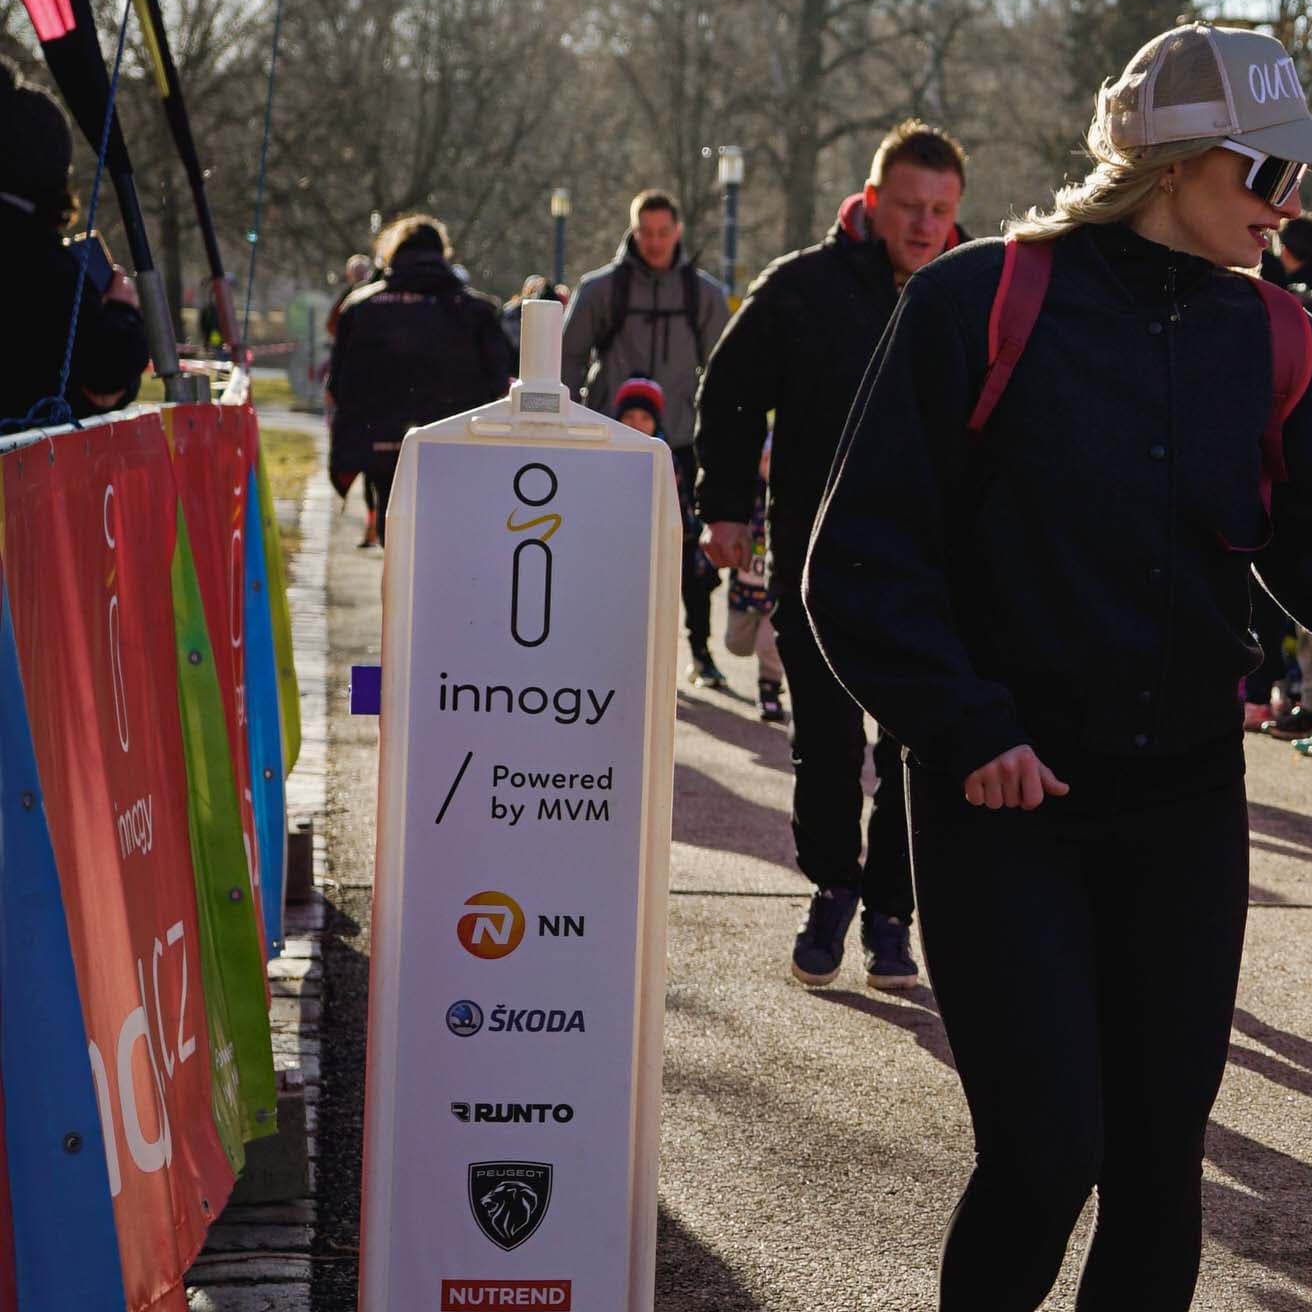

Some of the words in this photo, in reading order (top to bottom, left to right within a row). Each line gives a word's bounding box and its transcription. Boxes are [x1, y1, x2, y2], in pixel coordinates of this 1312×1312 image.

[440, 672, 615, 725] innogy
[492, 764, 613, 790] Powered
[491, 796, 525, 826] by
[538, 798, 610, 822] MVM
[538, 916, 585, 937] NN
[488, 1004, 586, 1033] ŠKODA
[474, 1103, 574, 1123] RUNTO
[476, 1169, 544, 1178] PEUGEOT
[449, 1288, 565, 1305] NUTREND
